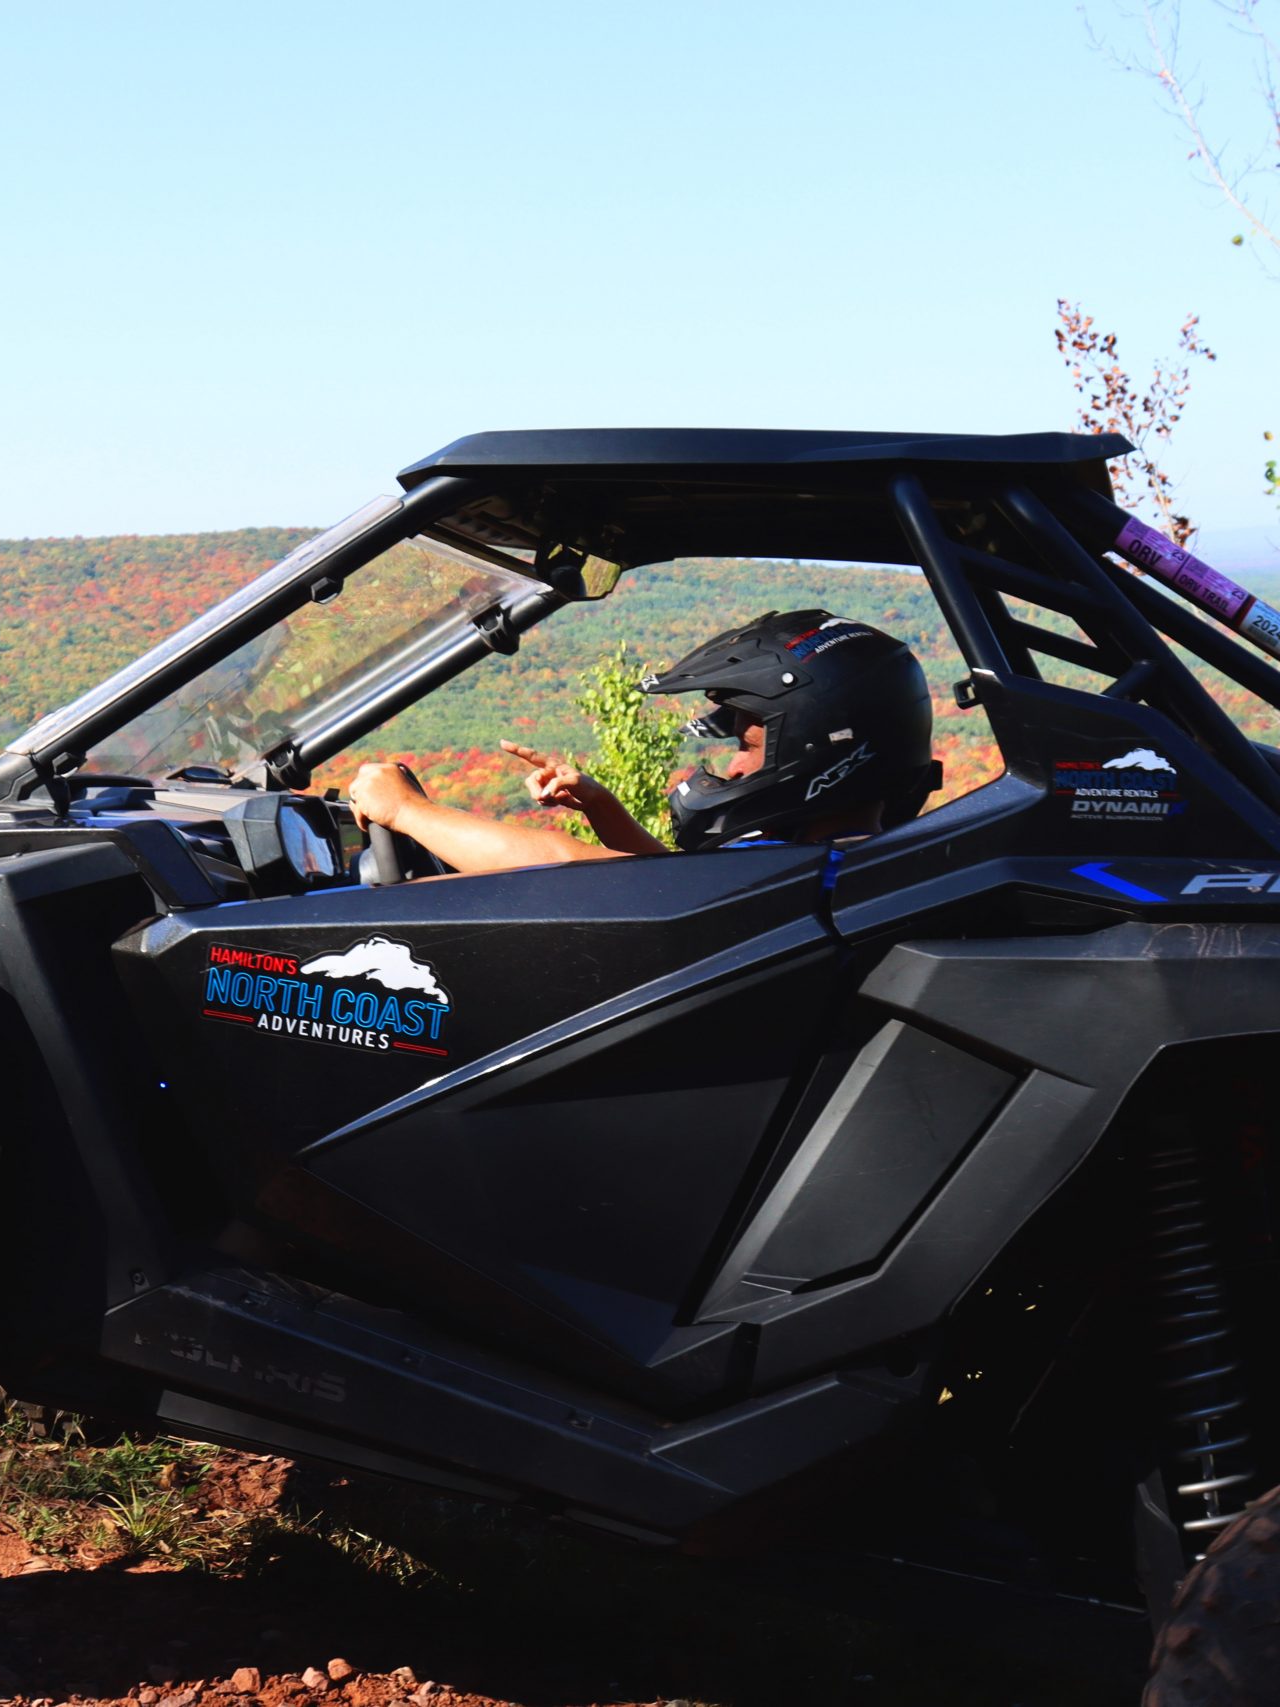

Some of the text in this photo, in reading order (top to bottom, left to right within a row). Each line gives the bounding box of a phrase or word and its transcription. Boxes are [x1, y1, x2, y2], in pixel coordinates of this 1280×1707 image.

[1128, 539, 1163, 566] ORV
[1171, 549, 1185, 562] 23
[1179, 574, 1202, 593] ORV
[1203, 588, 1231, 612] TRAIL
[1231, 587, 1246, 601] 23
[1055, 770, 1116, 789] NORTH
[1075, 788, 1159, 798] ADVENTURE RENTALS
[211, 946, 297, 975] HAMILTON'S
[206, 967, 450, 1040] NORTH COAST
[257, 1013, 390, 1050] ADVENTURES
